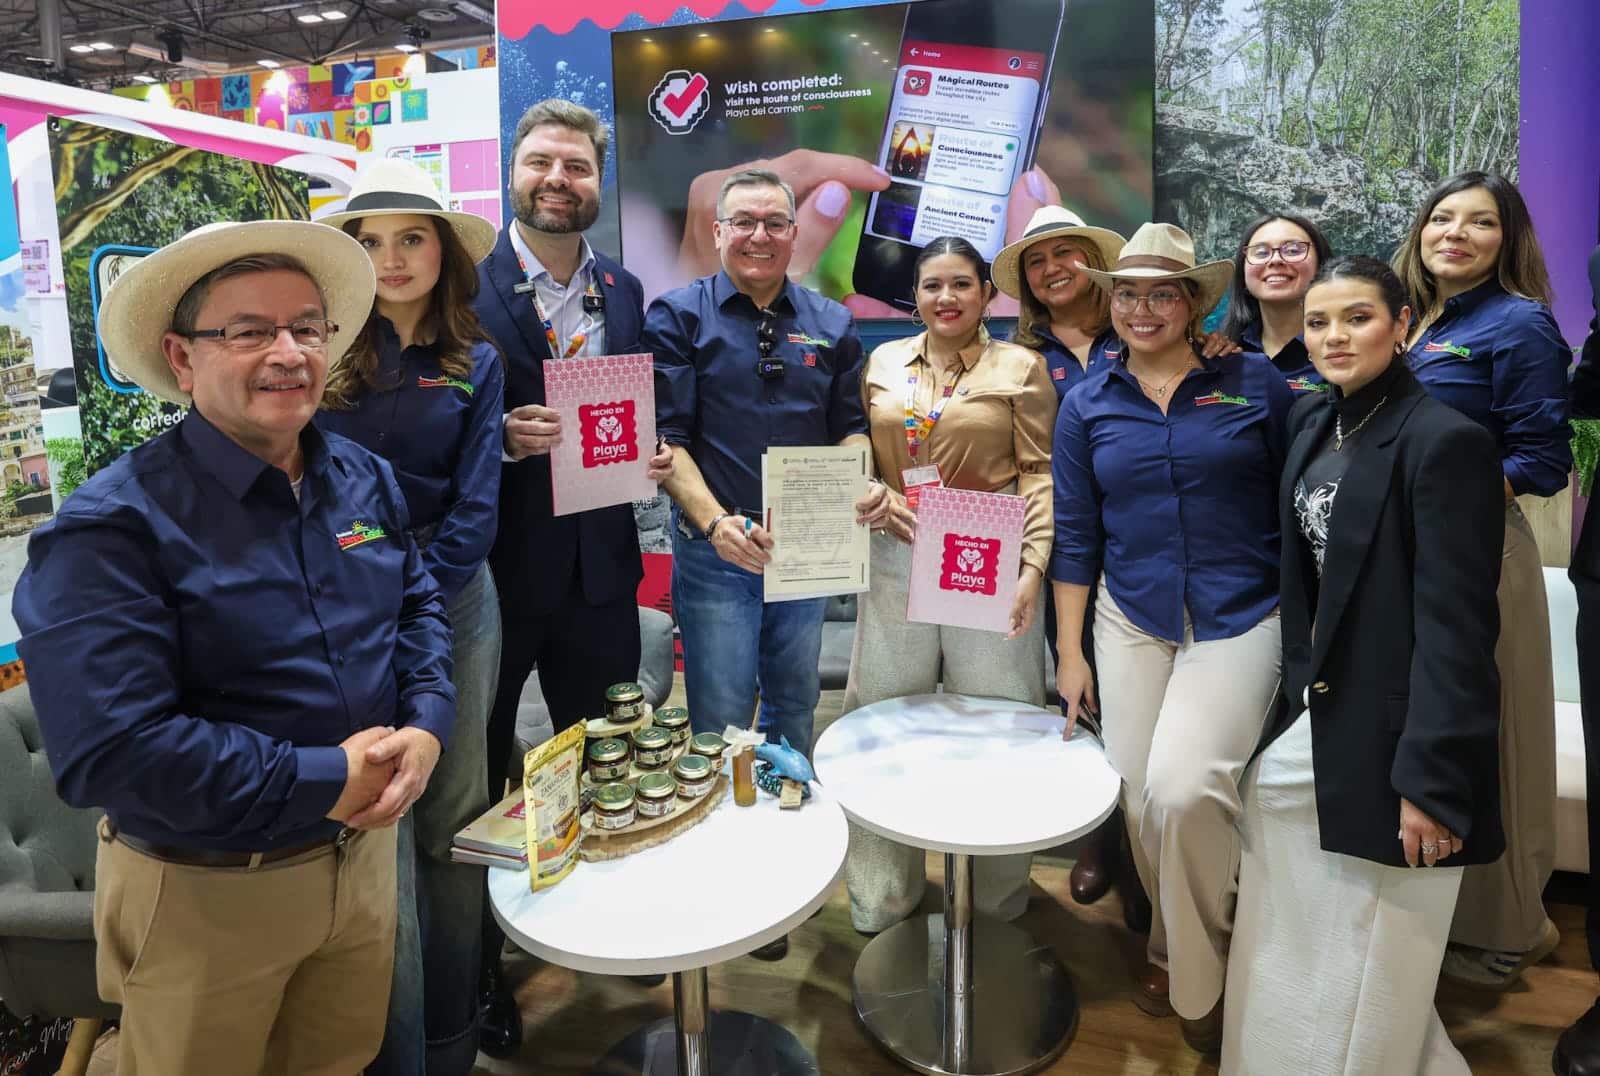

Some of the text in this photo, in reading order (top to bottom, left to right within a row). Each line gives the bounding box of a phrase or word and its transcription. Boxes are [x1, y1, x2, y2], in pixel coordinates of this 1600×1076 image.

[923, 50, 941, 58] Home
[725, 73, 843, 95] Wish completed:
[976, 79, 1010, 90] Routes
[725, 88, 872, 107] Visit the Route of Consciousness
[725, 105, 804, 118] Playa del Carmen
[938, 144, 1004, 160] Consciousness
[924, 205, 995, 224] Ancient Cenotes
[590, 408, 614, 417] HECHO
[593, 443, 628, 459] Playa
[954, 539, 989, 550] HECHO EN
[951, 573, 985, 588] Playa
